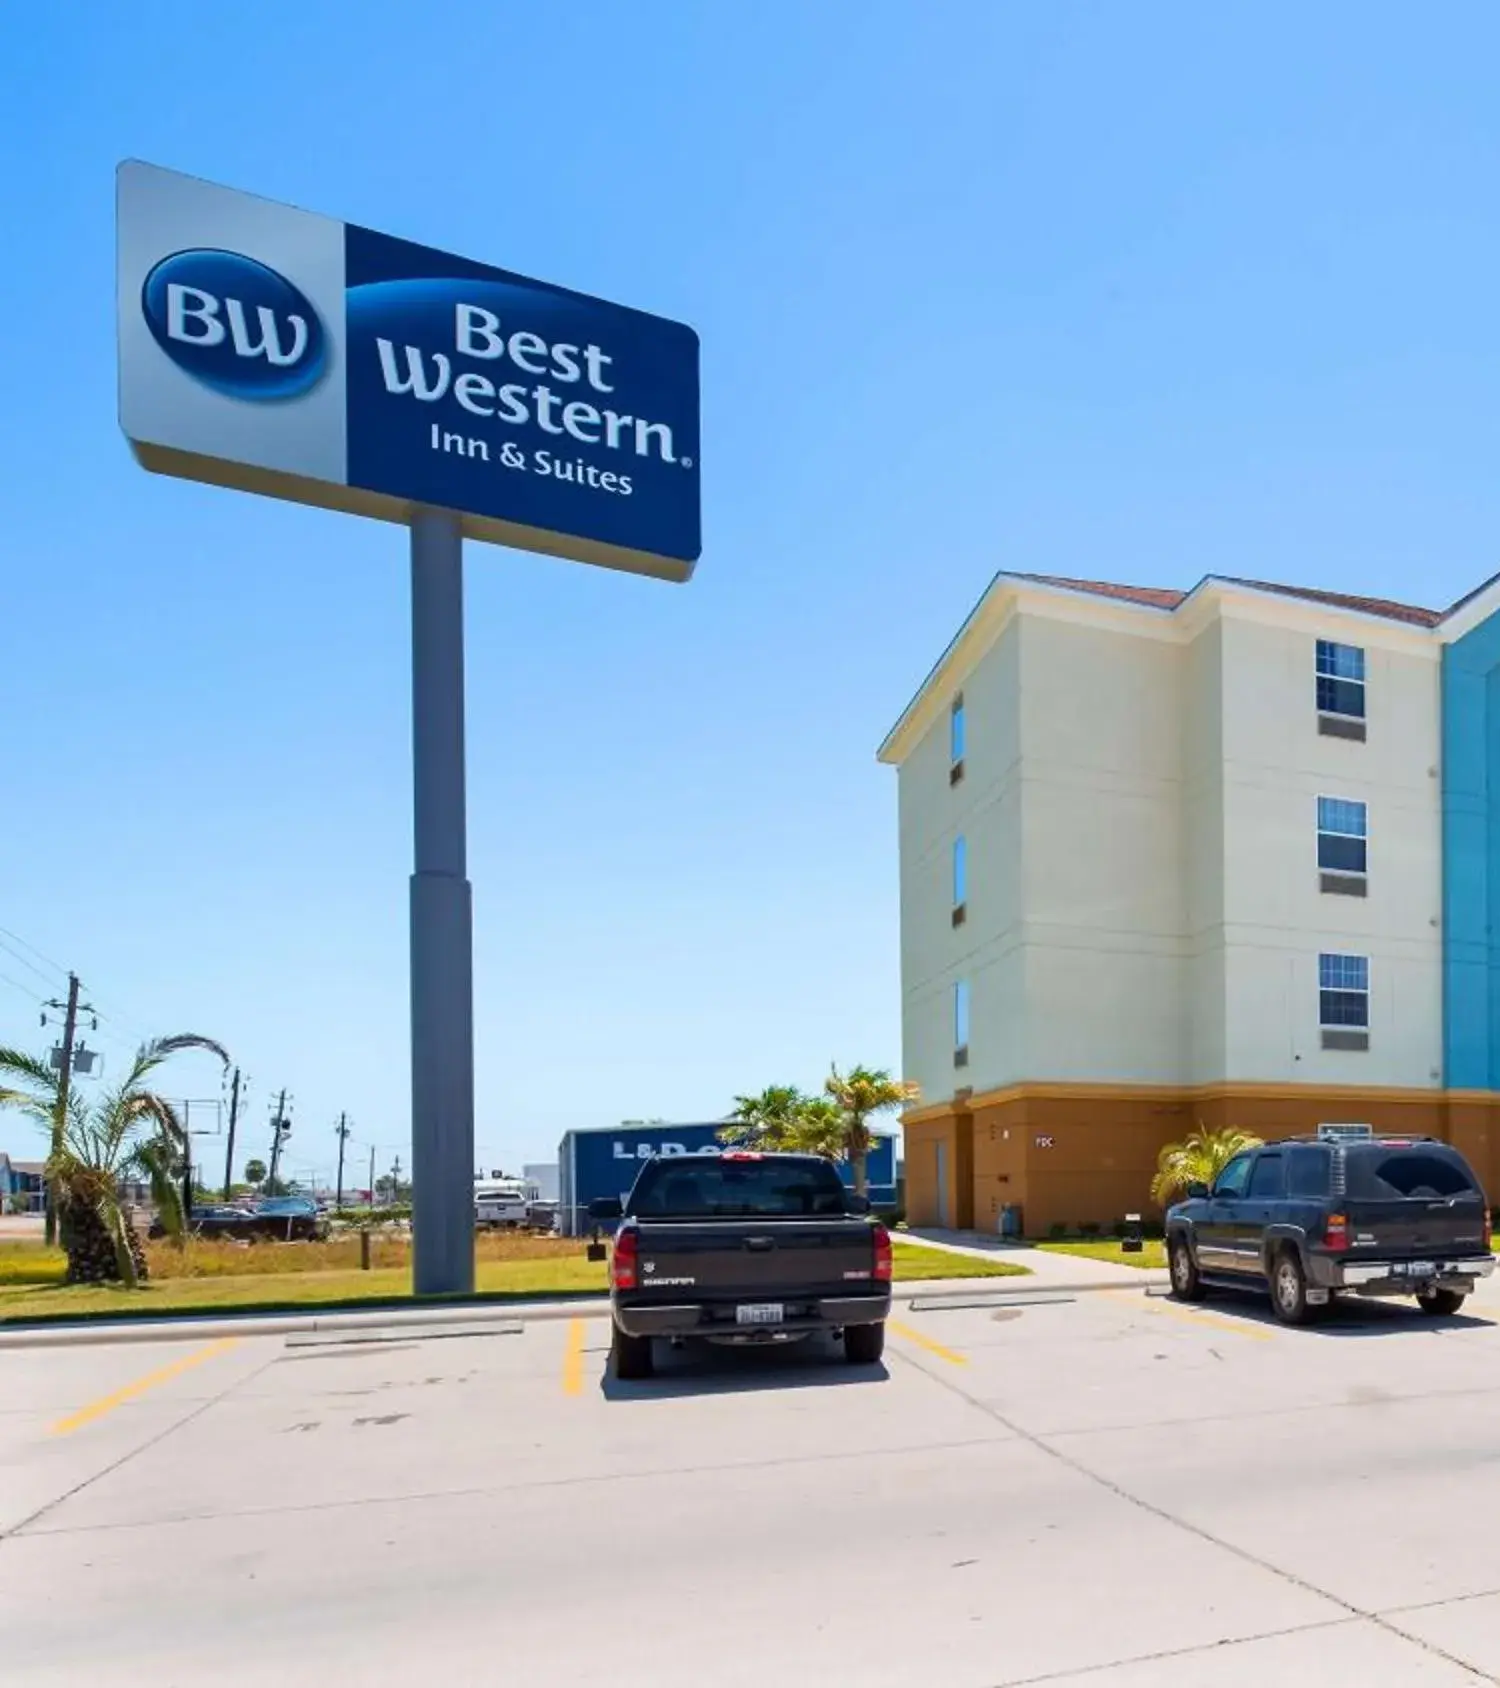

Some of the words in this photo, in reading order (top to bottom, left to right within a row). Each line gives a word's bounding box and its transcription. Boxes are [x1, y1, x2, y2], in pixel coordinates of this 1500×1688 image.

[167, 283, 306, 366] BW
[455, 303, 614, 392] Best
[376, 337, 677, 463] Western
[431, 423, 489, 461] Inn
[500, 442, 526, 470] &
[534, 450, 633, 495] Suites
